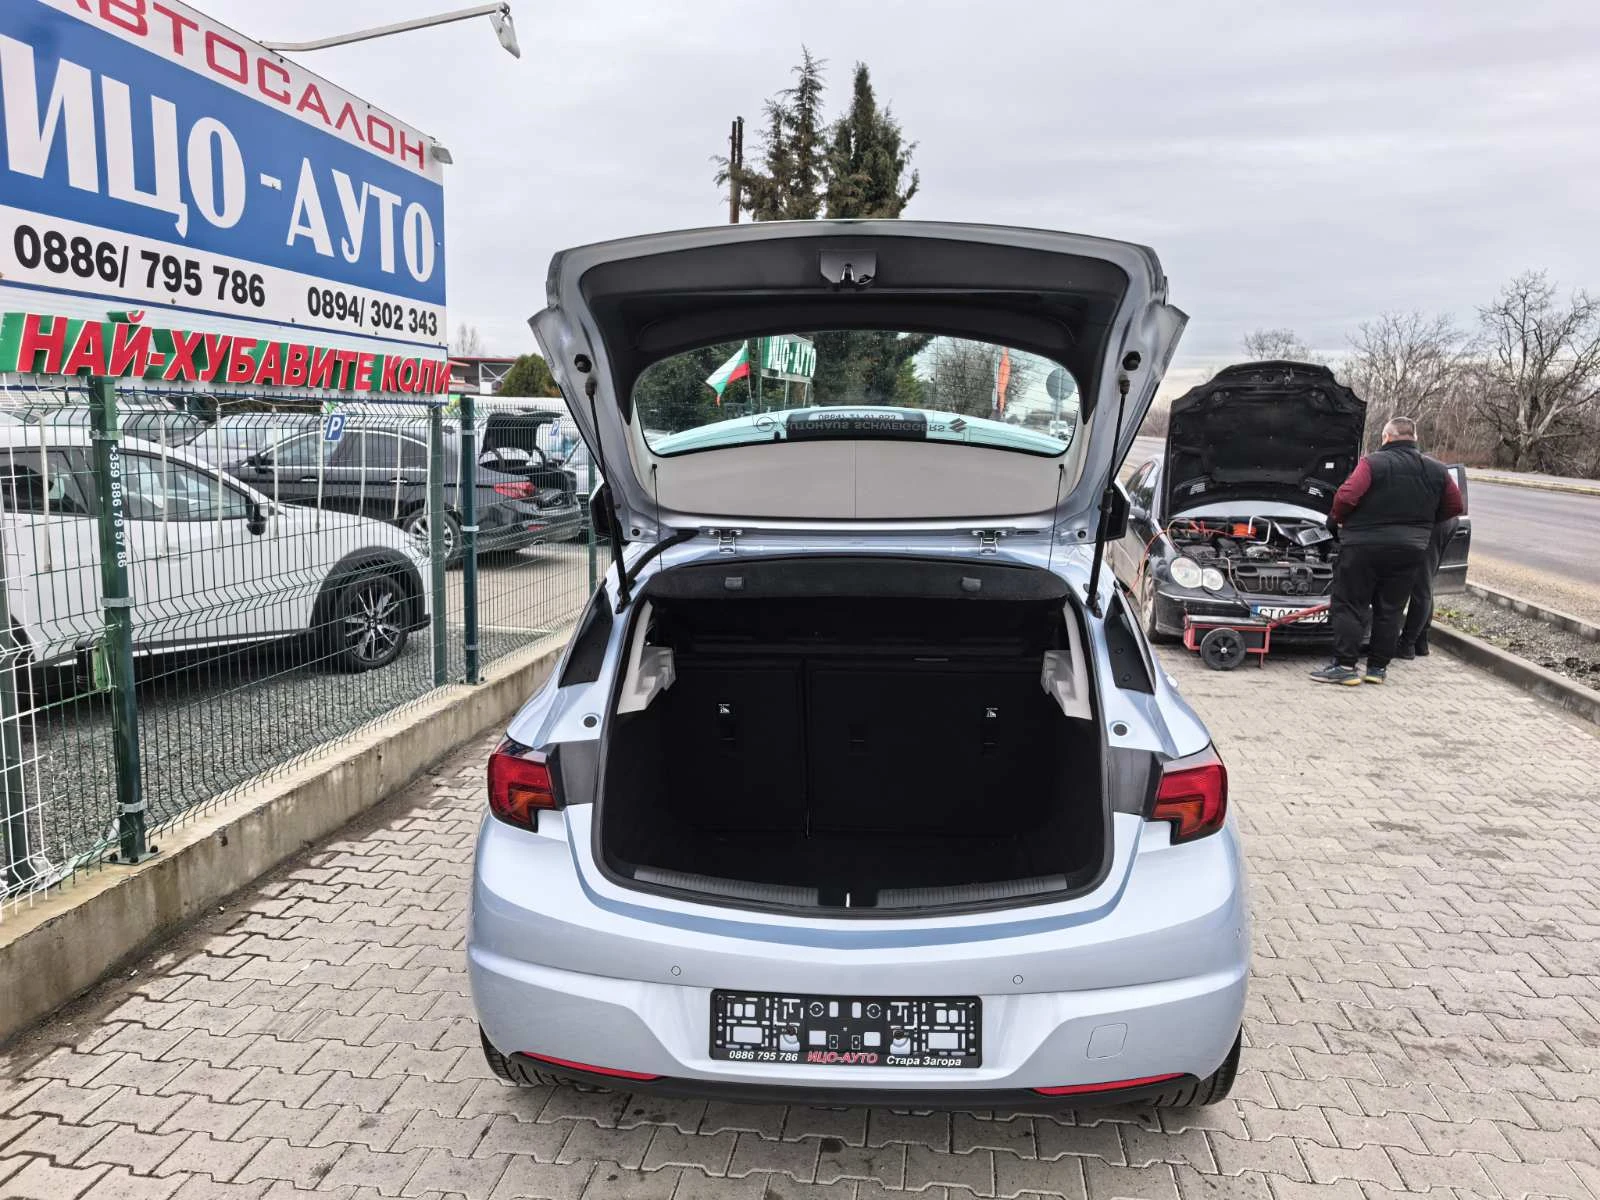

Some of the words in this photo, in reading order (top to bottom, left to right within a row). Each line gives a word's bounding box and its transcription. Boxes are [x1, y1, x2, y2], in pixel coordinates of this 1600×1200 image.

[74, 0, 425, 169] ВТОСАЛОН
[13, 225, 129, 288] 0886/
[140, 250, 202, 296] 795
[212, 265, 266, 307] 786
[307, 286, 366, 327] 0894/
[370, 299, 404, 331] 302
[408, 308, 438, 337] 343
[16, 310, 376, 392] НАЙ-ХУБАВИТЕ
[380, 354, 451, 394] КОЛИ
[109, 443, 120, 478] +359
[111, 482, 122, 507] 886
[113, 510, 124, 527] 79
[115, 531, 126, 546] 57
[117, 551, 128, 568] 86
[729, 1050, 755, 1060] 0886
[757, 1051, 777, 1061] 795
[779, 1052, 799, 1062] 786
[886, 1055, 921, 1066] Стара
[923, 1056, 962, 1067] Загора
